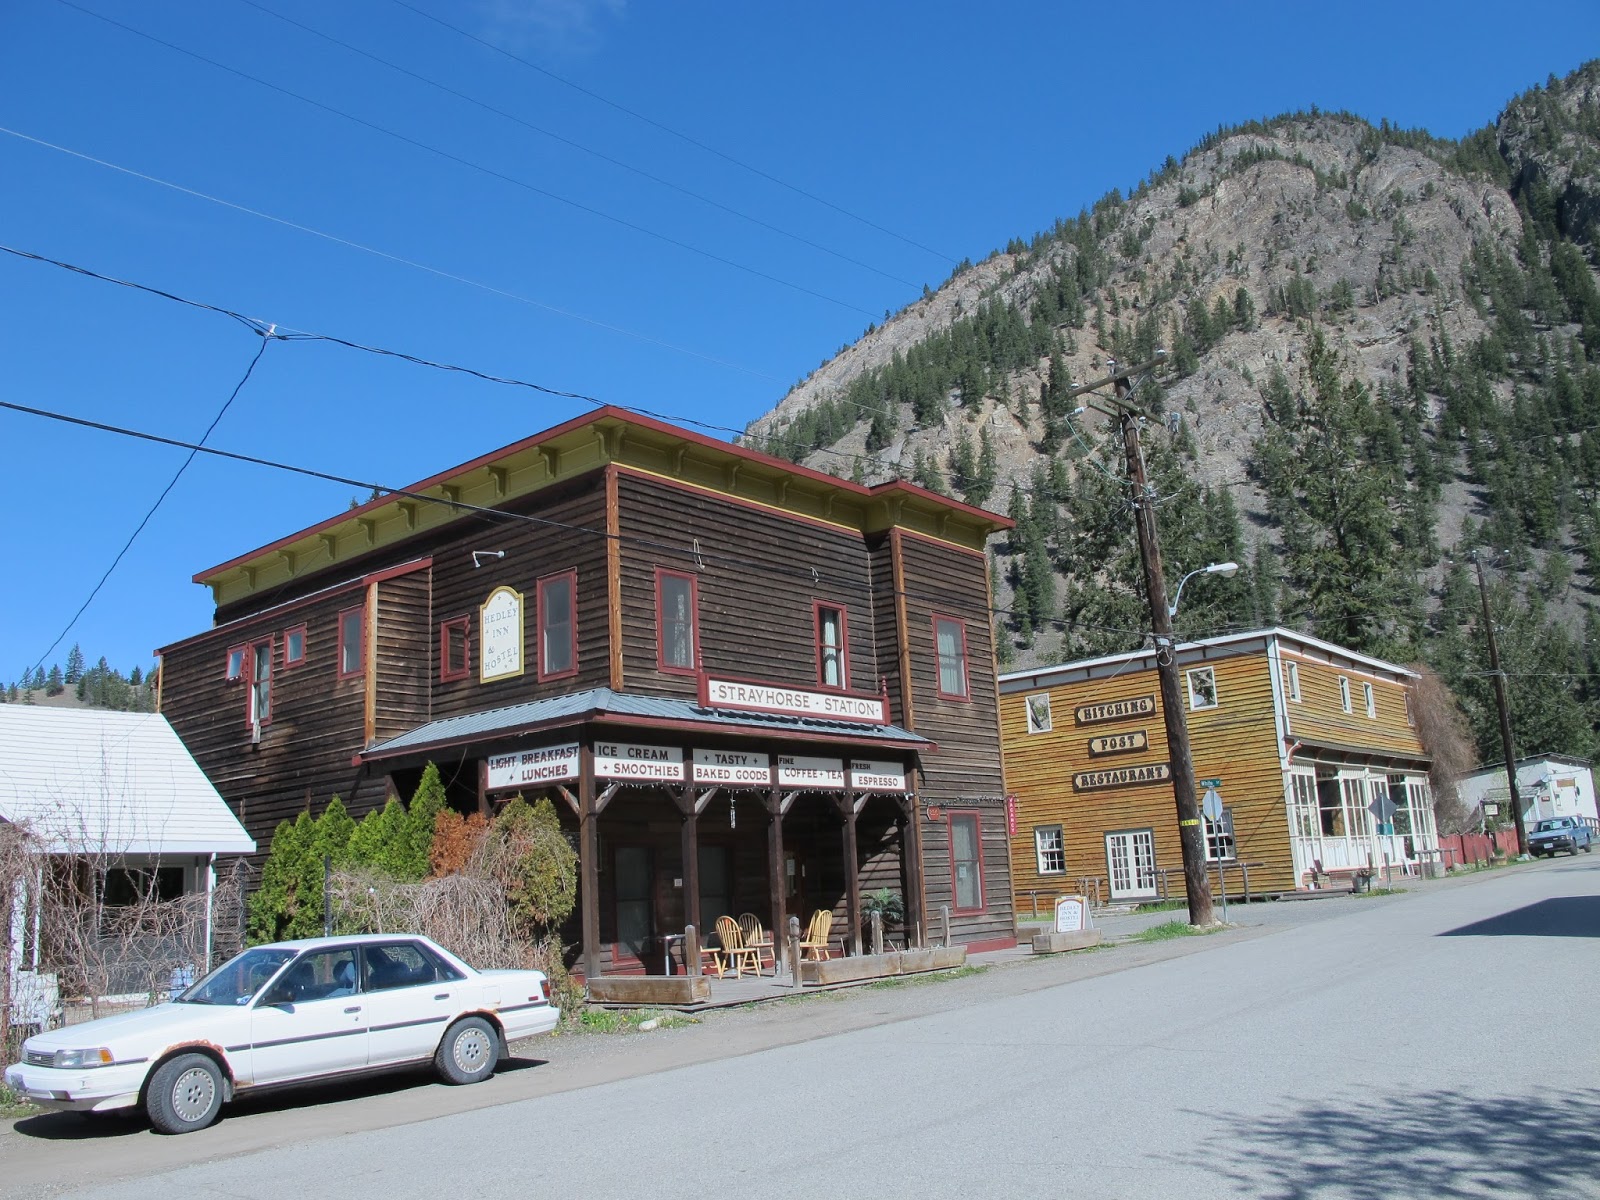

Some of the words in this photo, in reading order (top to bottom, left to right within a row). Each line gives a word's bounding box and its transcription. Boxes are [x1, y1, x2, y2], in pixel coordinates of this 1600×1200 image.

[485, 607, 517, 624] HEDLEY
[492, 625, 509, 638] INN
[487, 645, 495, 654] &
[485, 646, 518, 670] HOSTEL
[718, 685, 810, 708] STRAYHORSE
[824, 697, 875, 715] STATION
[1083, 699, 1148, 720] HITCHING
[1100, 735, 1135, 751] POST
[490, 755, 517, 770] LIGHT
[521, 745, 579, 764] BREAKFAST
[598, 745, 618, 757] ICE
[627, 747, 669, 760] CREAM
[714, 753, 748, 765] TASTY
[779, 757, 795, 765] FINE
[851, 762, 871, 770] FRESH
[521, 764, 568, 781] LUNCHES
[613, 762, 680, 776] SMOOTHIES
[696, 767, 731, 779] BAKED
[735, 769, 769, 780] GOODS
[784, 767, 818, 778] COFFEE
[826, 770, 843, 780] TEA
[858, 776, 899, 787] ESPRESSO
[1080, 766, 1163, 787] RESTAURANT
